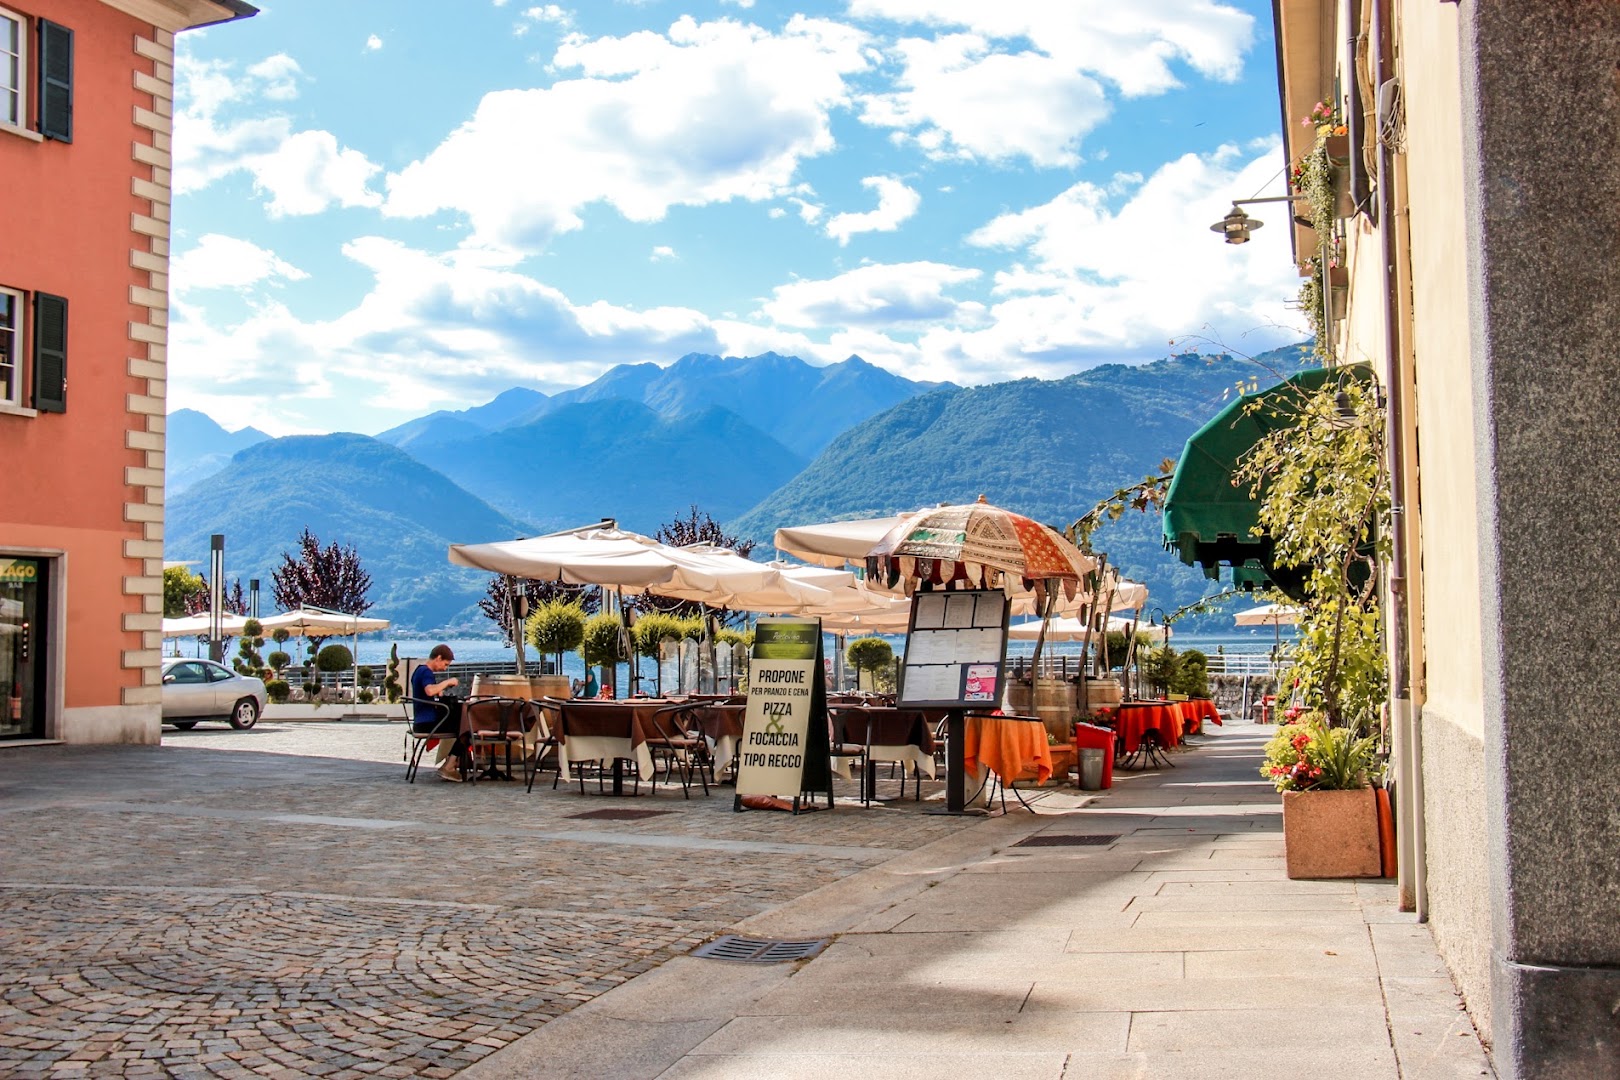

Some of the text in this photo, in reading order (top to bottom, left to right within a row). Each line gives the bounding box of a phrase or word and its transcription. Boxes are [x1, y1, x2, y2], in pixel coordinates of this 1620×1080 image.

[759, 670, 805, 683] PROPONE
[751, 687, 809, 696] PER PRANZO E CENA
[763, 702, 792, 715] PIZZA
[766, 712, 784, 736] &
[750, 732, 798, 746] FOCACCIA
[744, 753, 802, 768] TIPO RECCO
